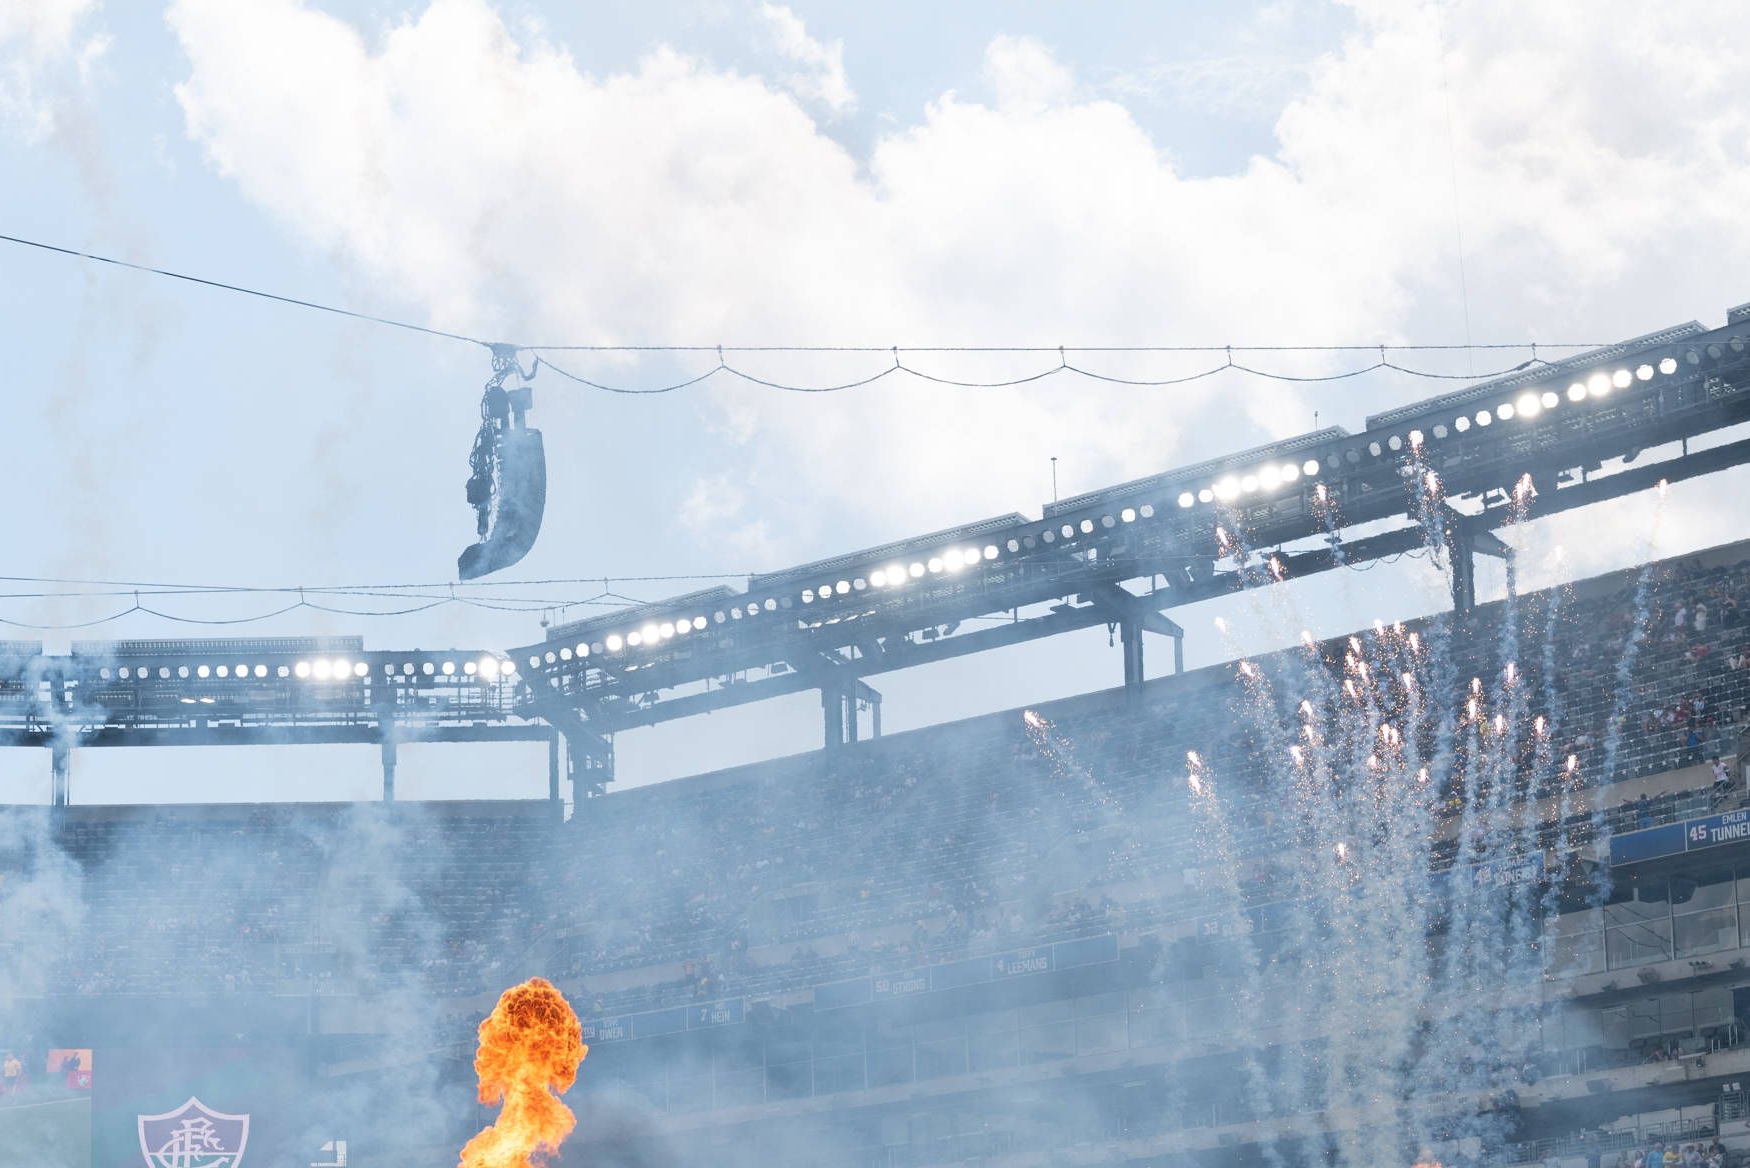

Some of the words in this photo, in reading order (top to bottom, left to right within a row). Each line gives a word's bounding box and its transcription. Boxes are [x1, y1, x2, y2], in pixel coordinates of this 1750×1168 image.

[1722, 811, 1747, 825] EMLEN
[1690, 824, 1707, 841] 45
[1007, 957, 1048, 975] LEEMANS
[700, 1009, 707, 1022] 7
[711, 1008, 730, 1024] HEIN
[599, 1027, 624, 1041] OWEN
